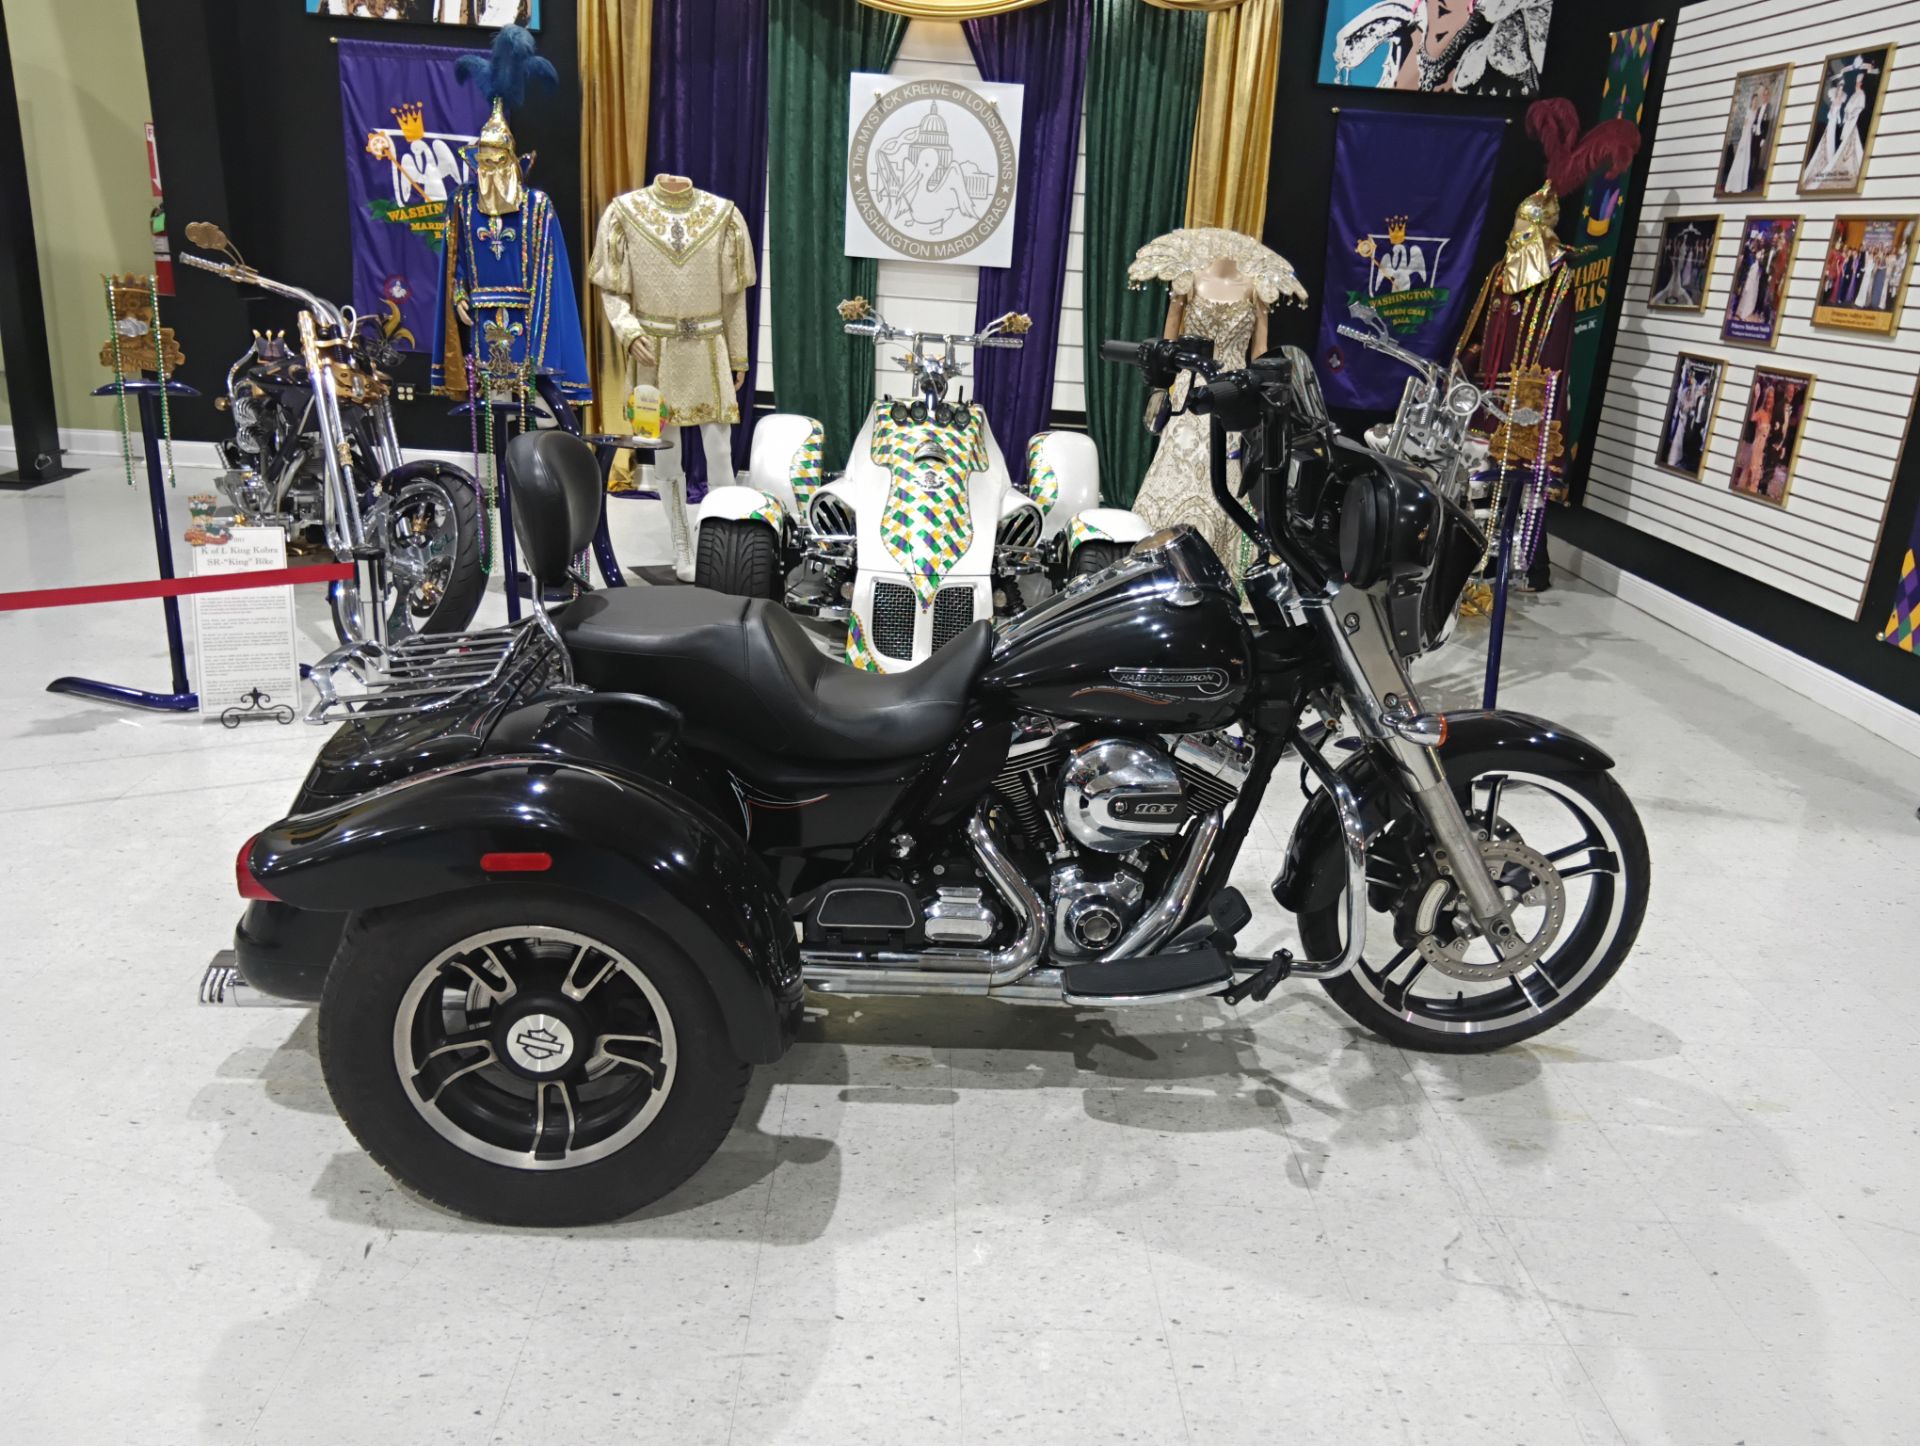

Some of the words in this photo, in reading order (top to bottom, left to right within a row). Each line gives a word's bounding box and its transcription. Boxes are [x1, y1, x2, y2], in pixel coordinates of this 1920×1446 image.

[852, 140, 866, 167] The
[862, 92, 902, 143] MYSTICK
[903, 83, 949, 100] KREWE
[952, 89, 966, 100] of
[966, 92, 1013, 180] LOUISIANIANS
[386, 202, 445, 222] WASHIN
[855, 186, 930, 257] WASHINGTON
[934, 232, 979, 257] MARDI
[979, 197, 1007, 235] GRAS
[1368, 289, 1435, 308] WASHINGTON
[1574, 278, 1607, 312] RAS
[230, 546, 251, 556] King
[255, 557, 274, 565] Bike
[1120, 672, 1215, 684] HARLEY-DAVIDSON
[1135, 803, 1178, 815] 103
